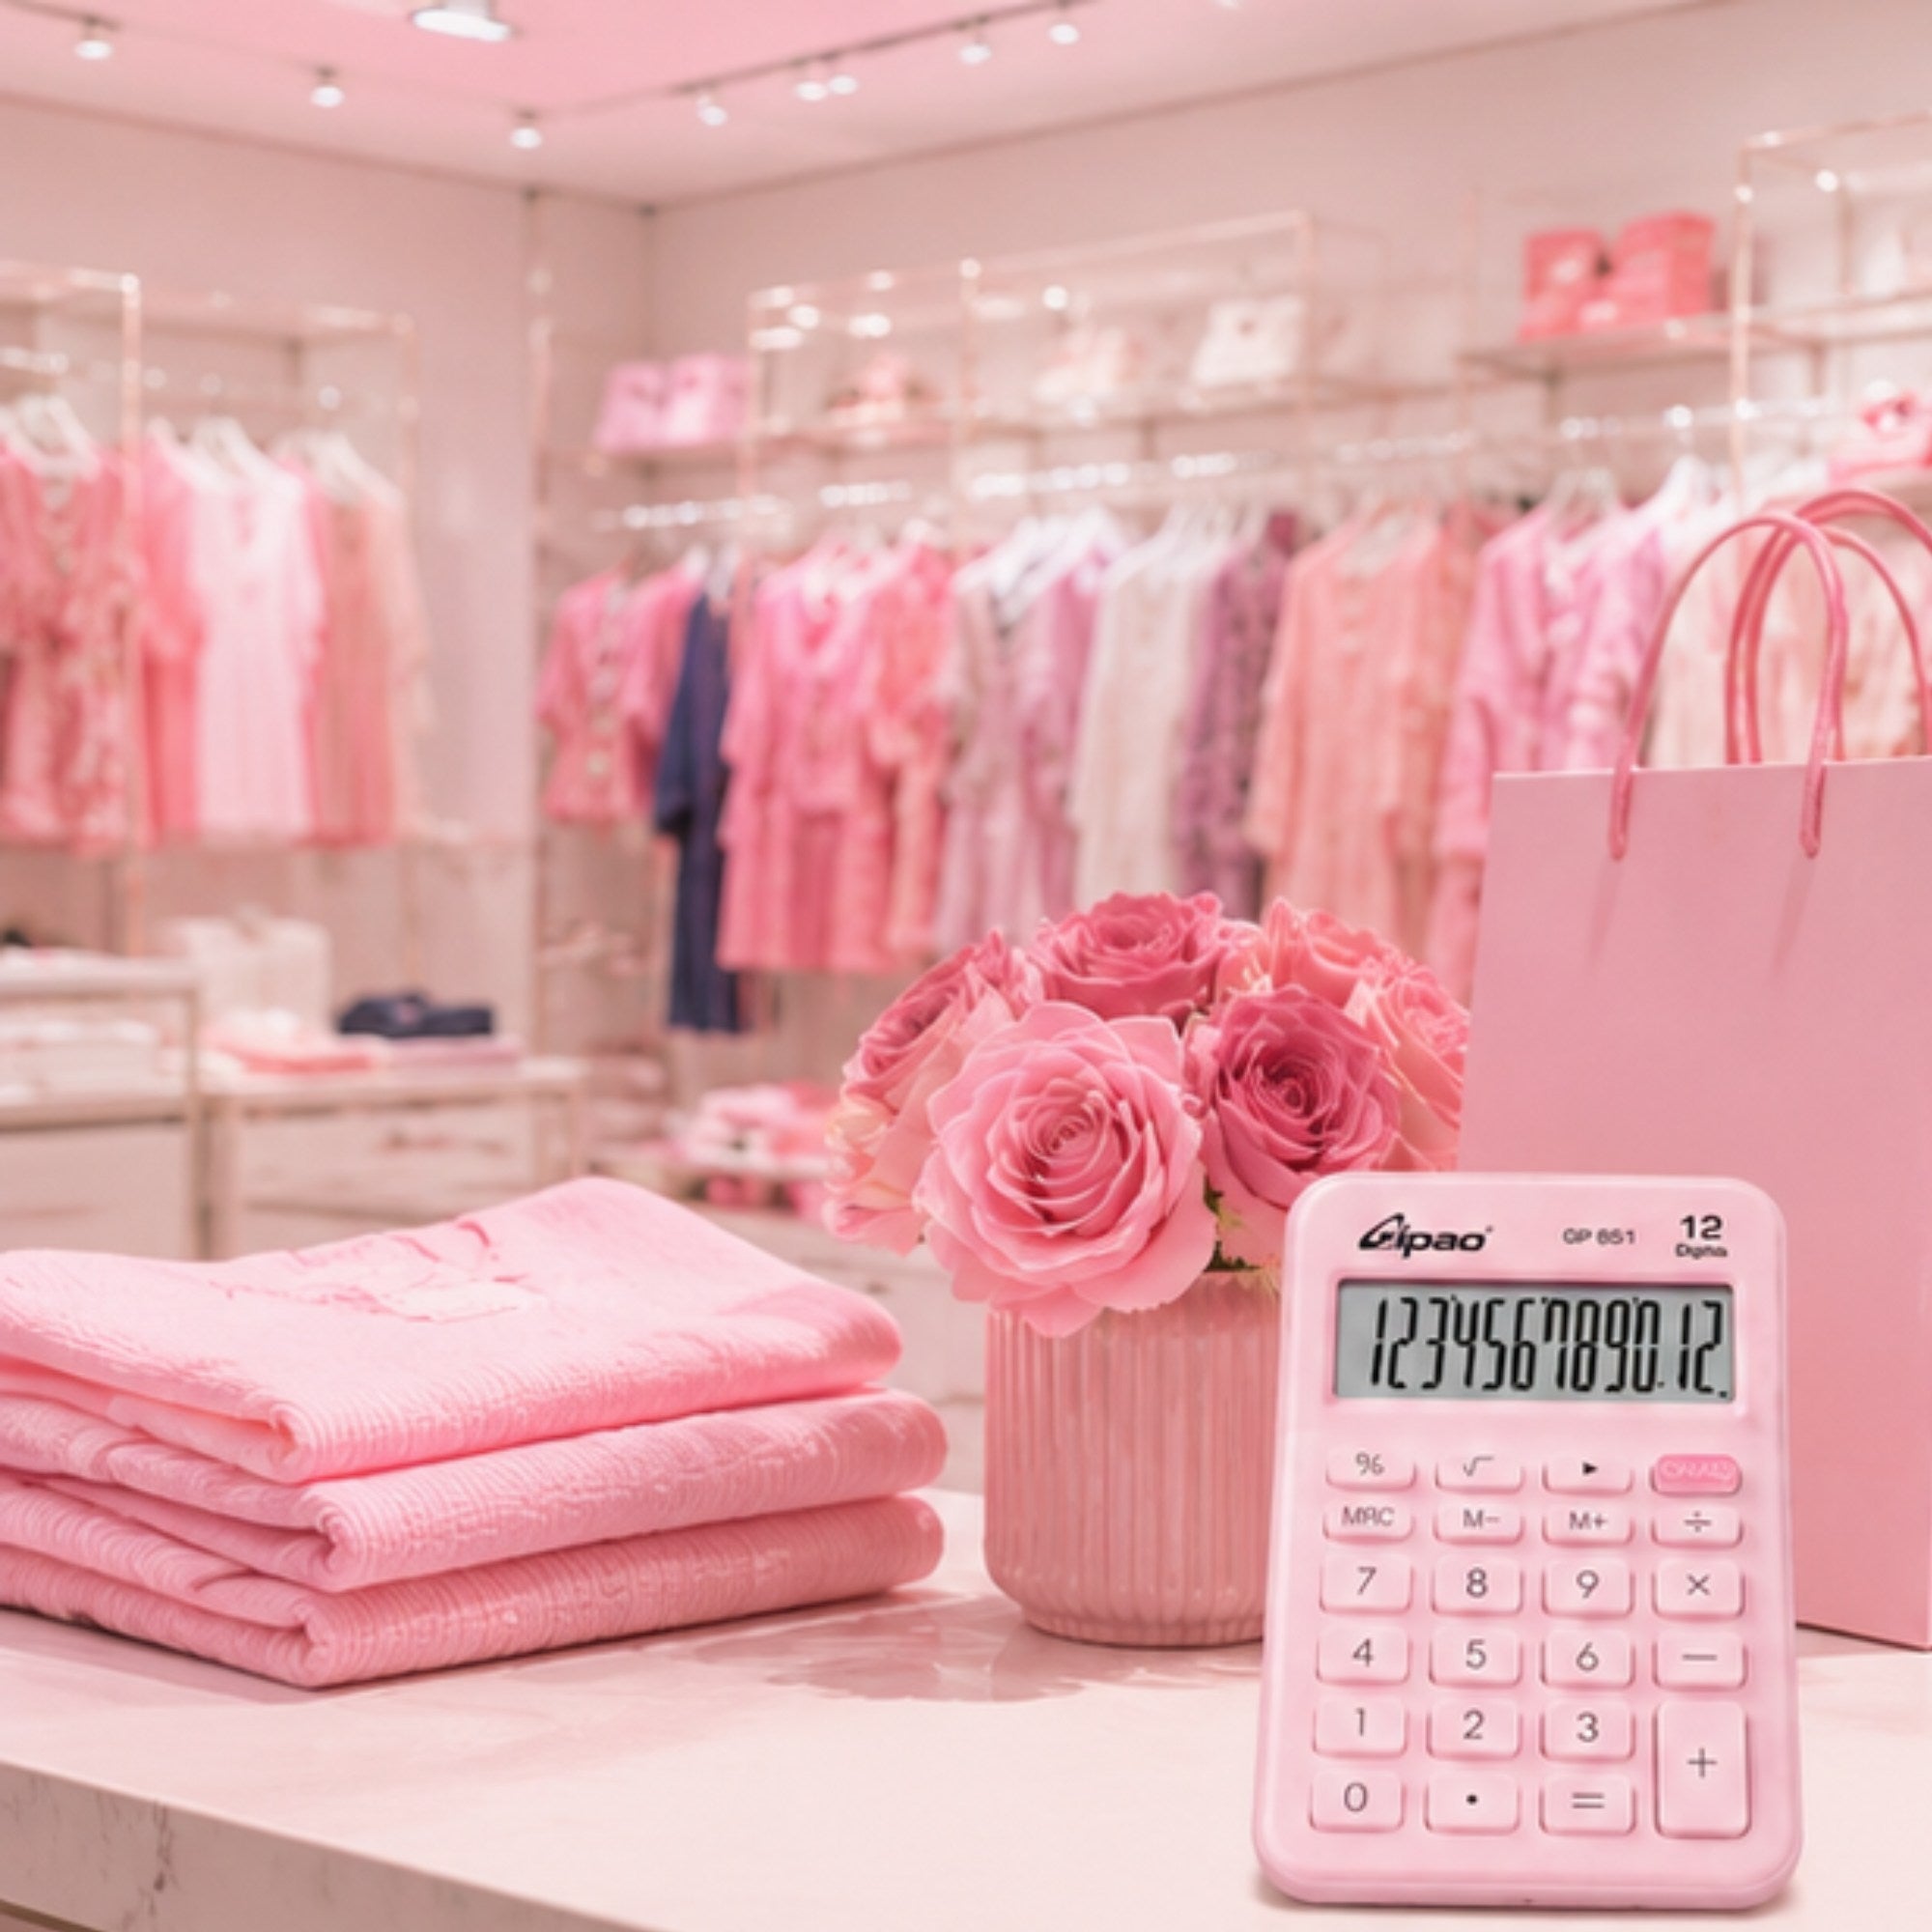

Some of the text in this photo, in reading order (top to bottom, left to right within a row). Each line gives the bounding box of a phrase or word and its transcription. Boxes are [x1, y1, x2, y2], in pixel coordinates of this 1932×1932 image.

[1680, 1214, 1722, 1240] 12
[1357, 1566, 1377, 1595] 7
[1465, 1567, 1489, 1599] 8
[1576, 1569, 1600, 1599] 9
[1351, 1637, 1374, 1667] 4
[1465, 1638, 1488, 1669] 5
[1576, 1641, 1600, 1672] 6
[1355, 1707, 1367, 1737] 1
[1463, 1709, 1486, 1741] 2
[1577, 1711, 1600, 1743] 3
